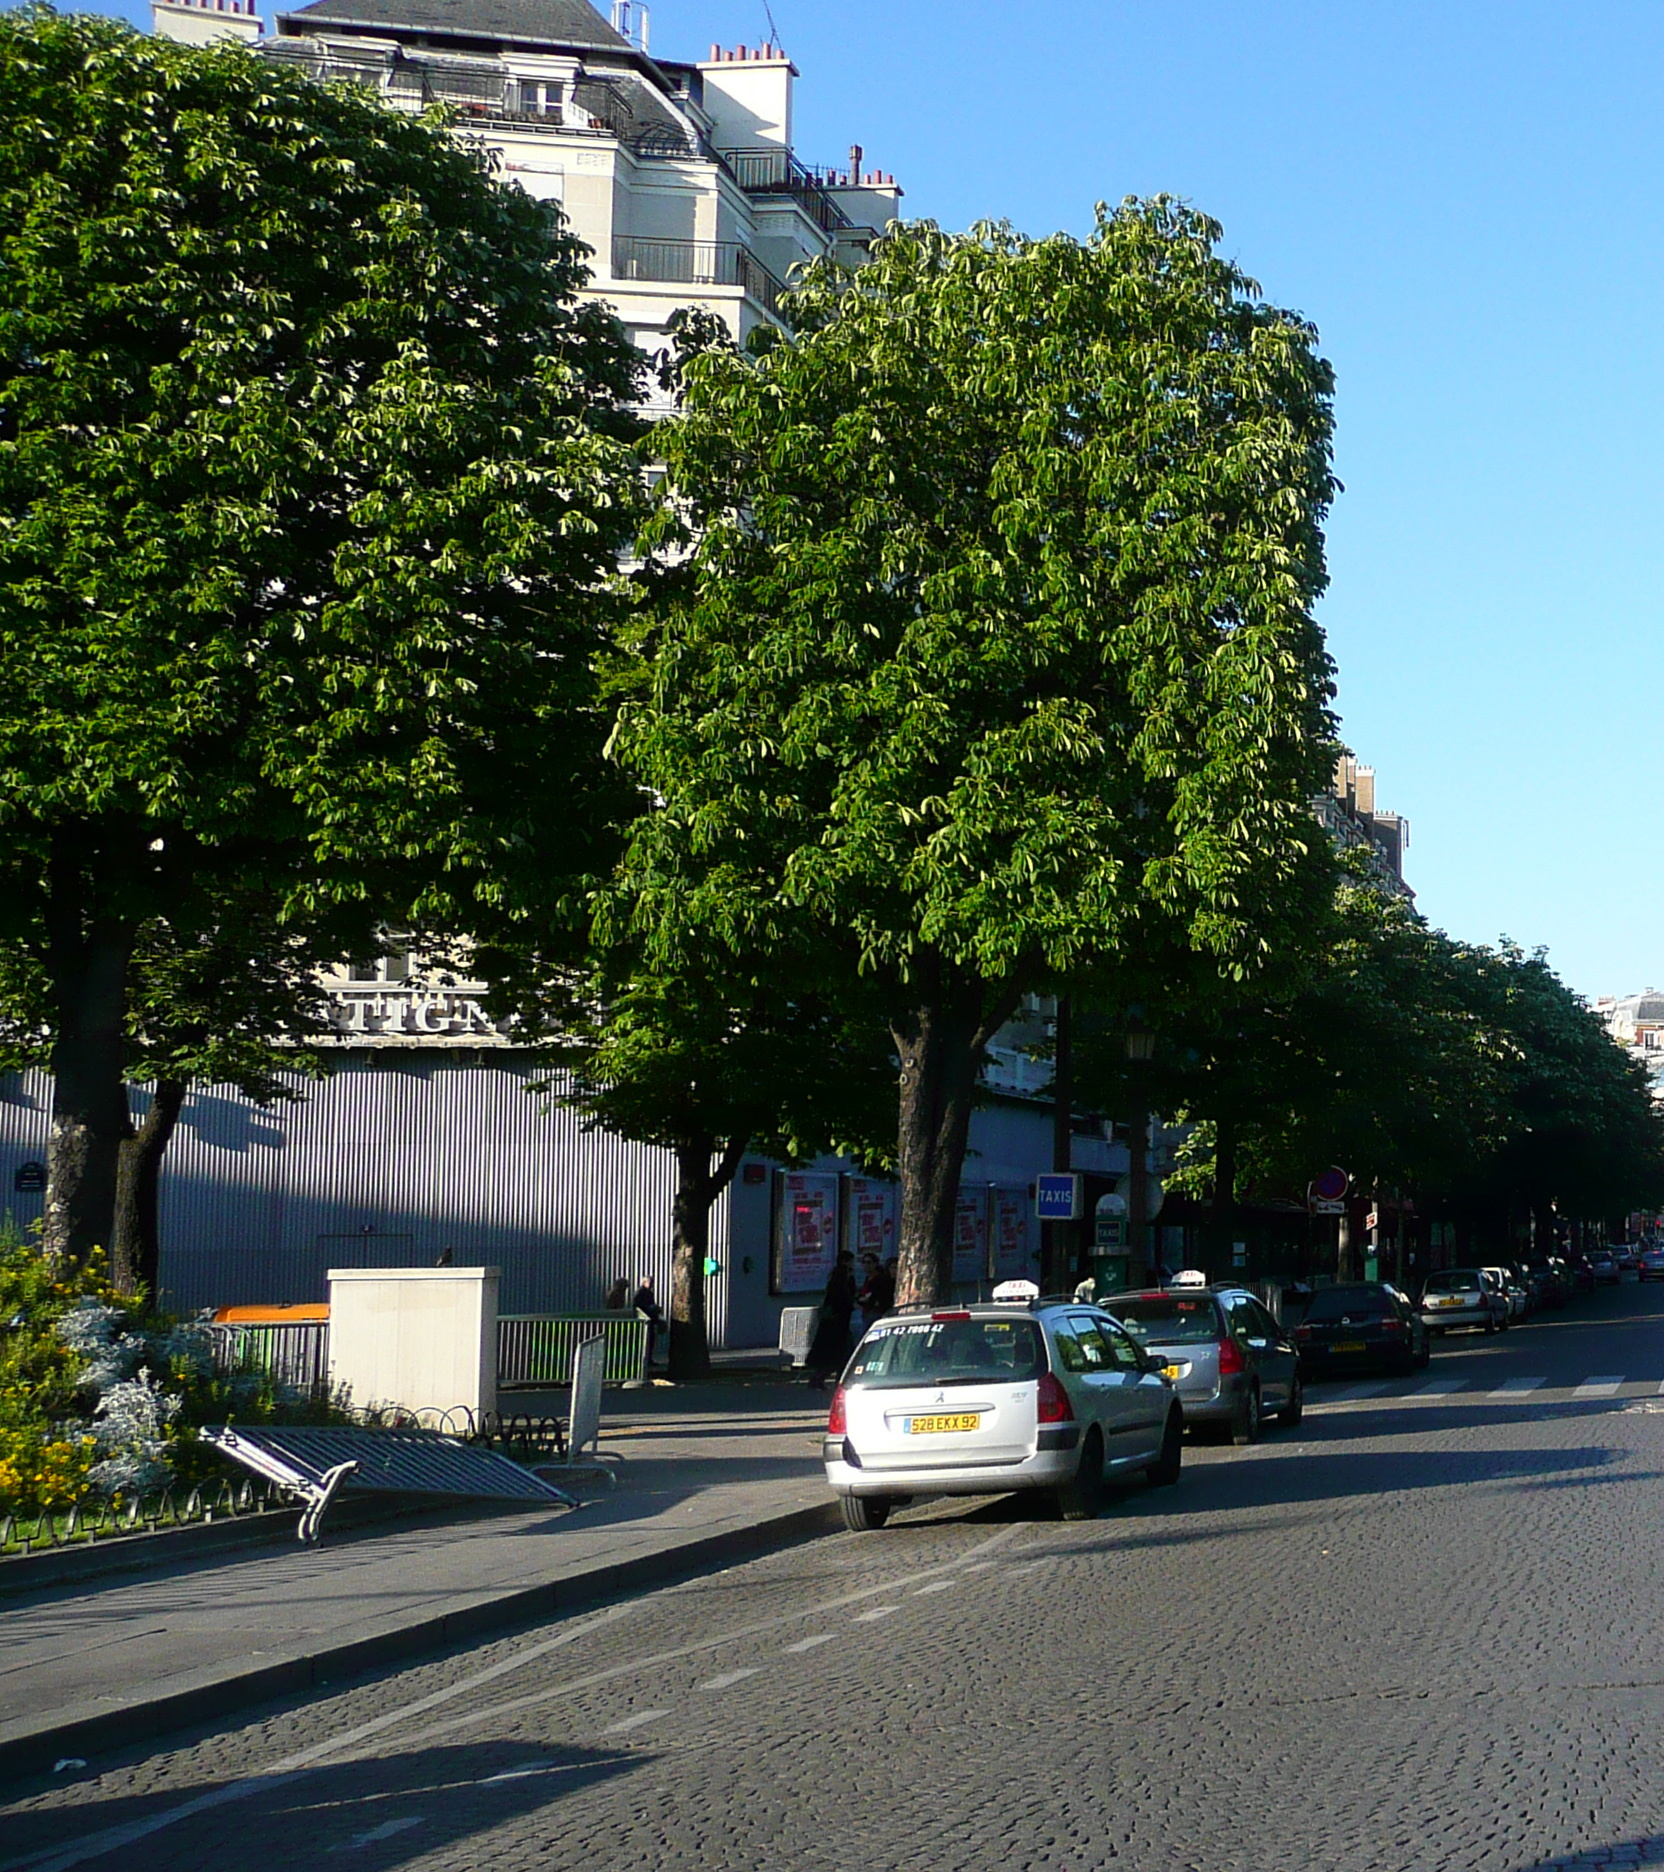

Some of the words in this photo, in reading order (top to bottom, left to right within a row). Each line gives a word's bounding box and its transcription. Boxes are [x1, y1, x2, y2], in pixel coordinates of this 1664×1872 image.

[1039, 1189, 1072, 1203] TAXIS
[1007, 1281, 1026, 1289] TAXI
[911, 1417, 934, 1432] 528
[936, 1416, 960, 1431] EKX
[961, 1415, 978, 1429] 92
